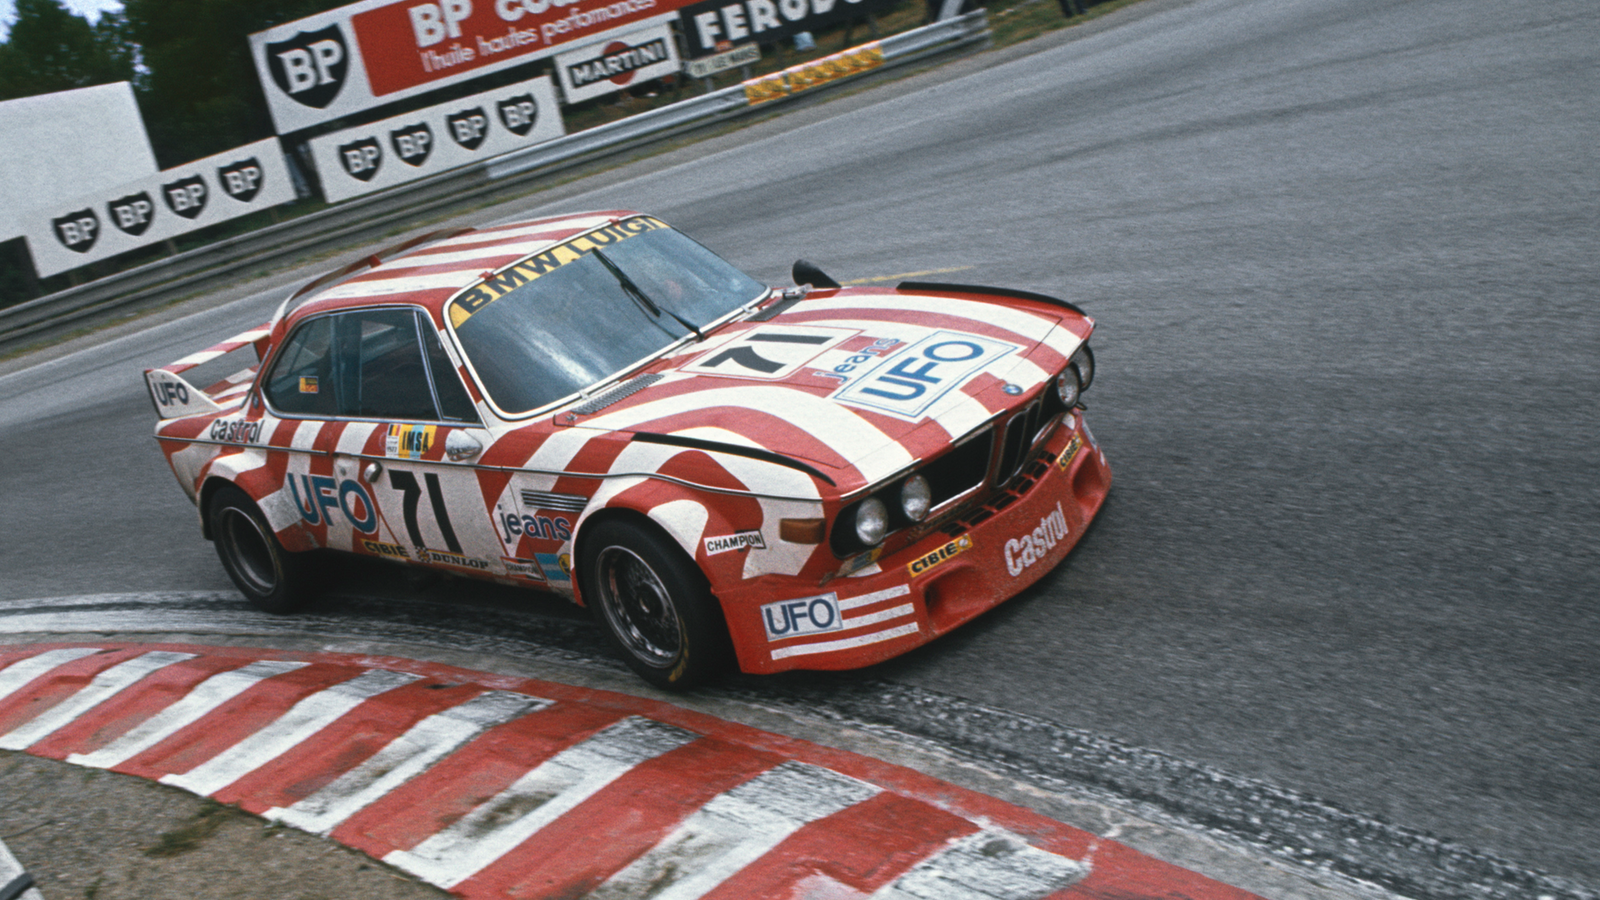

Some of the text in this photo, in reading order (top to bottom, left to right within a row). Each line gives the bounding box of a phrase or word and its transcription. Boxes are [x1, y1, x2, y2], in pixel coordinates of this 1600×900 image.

[407, 0, 474, 48] BP
[419, 43, 475, 73] l'huile
[476, 26, 538, 57] hautes
[571, 41, 667, 85] MARTINI
[275, 39, 343, 94] BP
[452, 115, 486, 143] BP
[502, 101, 535, 129] BP
[344, 145, 379, 174] BP
[396, 131, 430, 159] BP
[223, 166, 260, 195] BP
[168, 183, 205, 211] BP
[113, 200, 151, 228] BP
[58, 217, 97, 246] BP
[455, 216, 660, 314] BMW LUIGI
[698, 333, 835, 374] 71
[812, 338, 900, 384] jeans
[859, 340, 985, 401] UFO
[153, 382, 189, 406] UFO
[210, 418, 265, 443] Castrol
[402, 430, 430, 452] IMSA
[288, 472, 378, 534] UFO
[388, 469, 464, 554] 71
[498, 504, 572, 544] jeans
[1004, 501, 1069, 577] Castrol
[706, 532, 762, 553] CHAMPION
[911, 541, 958, 573] CIBIE
[431, 552, 489, 569] DUNLOP
[765, 597, 836, 635] UFO
